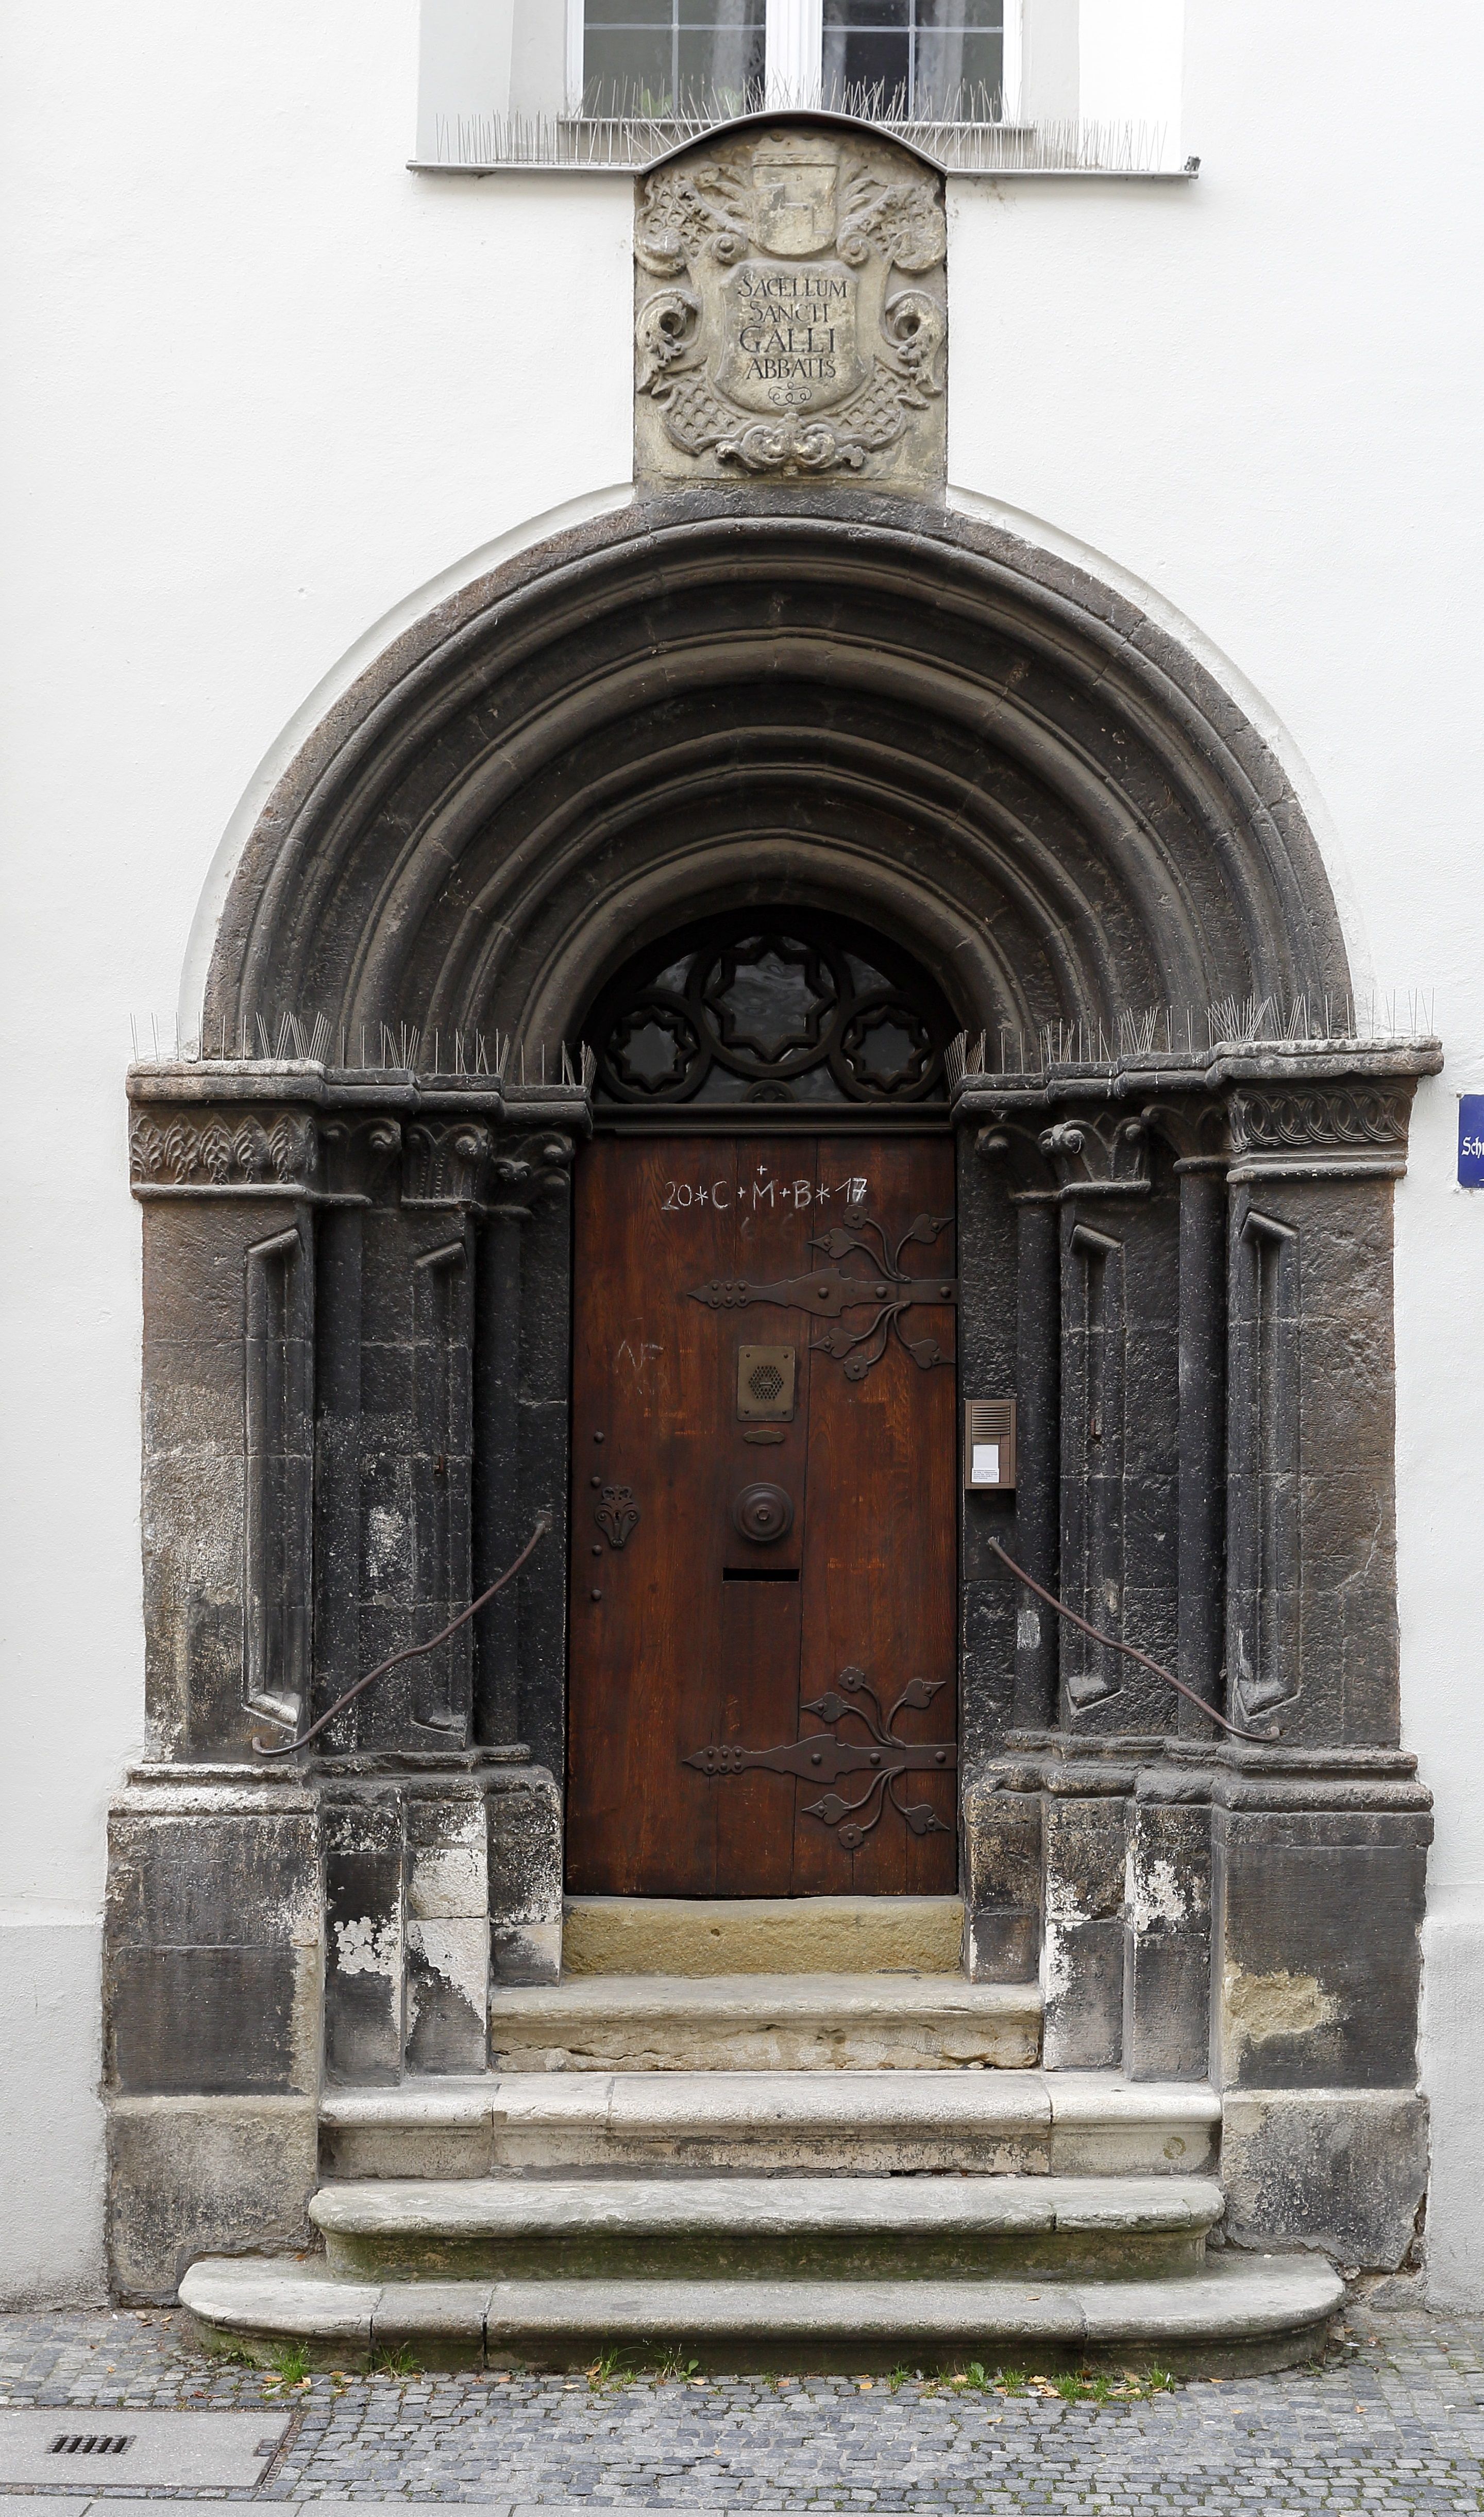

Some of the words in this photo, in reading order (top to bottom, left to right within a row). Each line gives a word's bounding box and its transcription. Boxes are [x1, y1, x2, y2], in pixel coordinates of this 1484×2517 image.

[737, 275, 848, 297] SACELLUM
[749, 301, 829, 323] SANCTI
[739, 325, 835, 353] GALLI
[746, 358, 836, 380] ABBATIS
